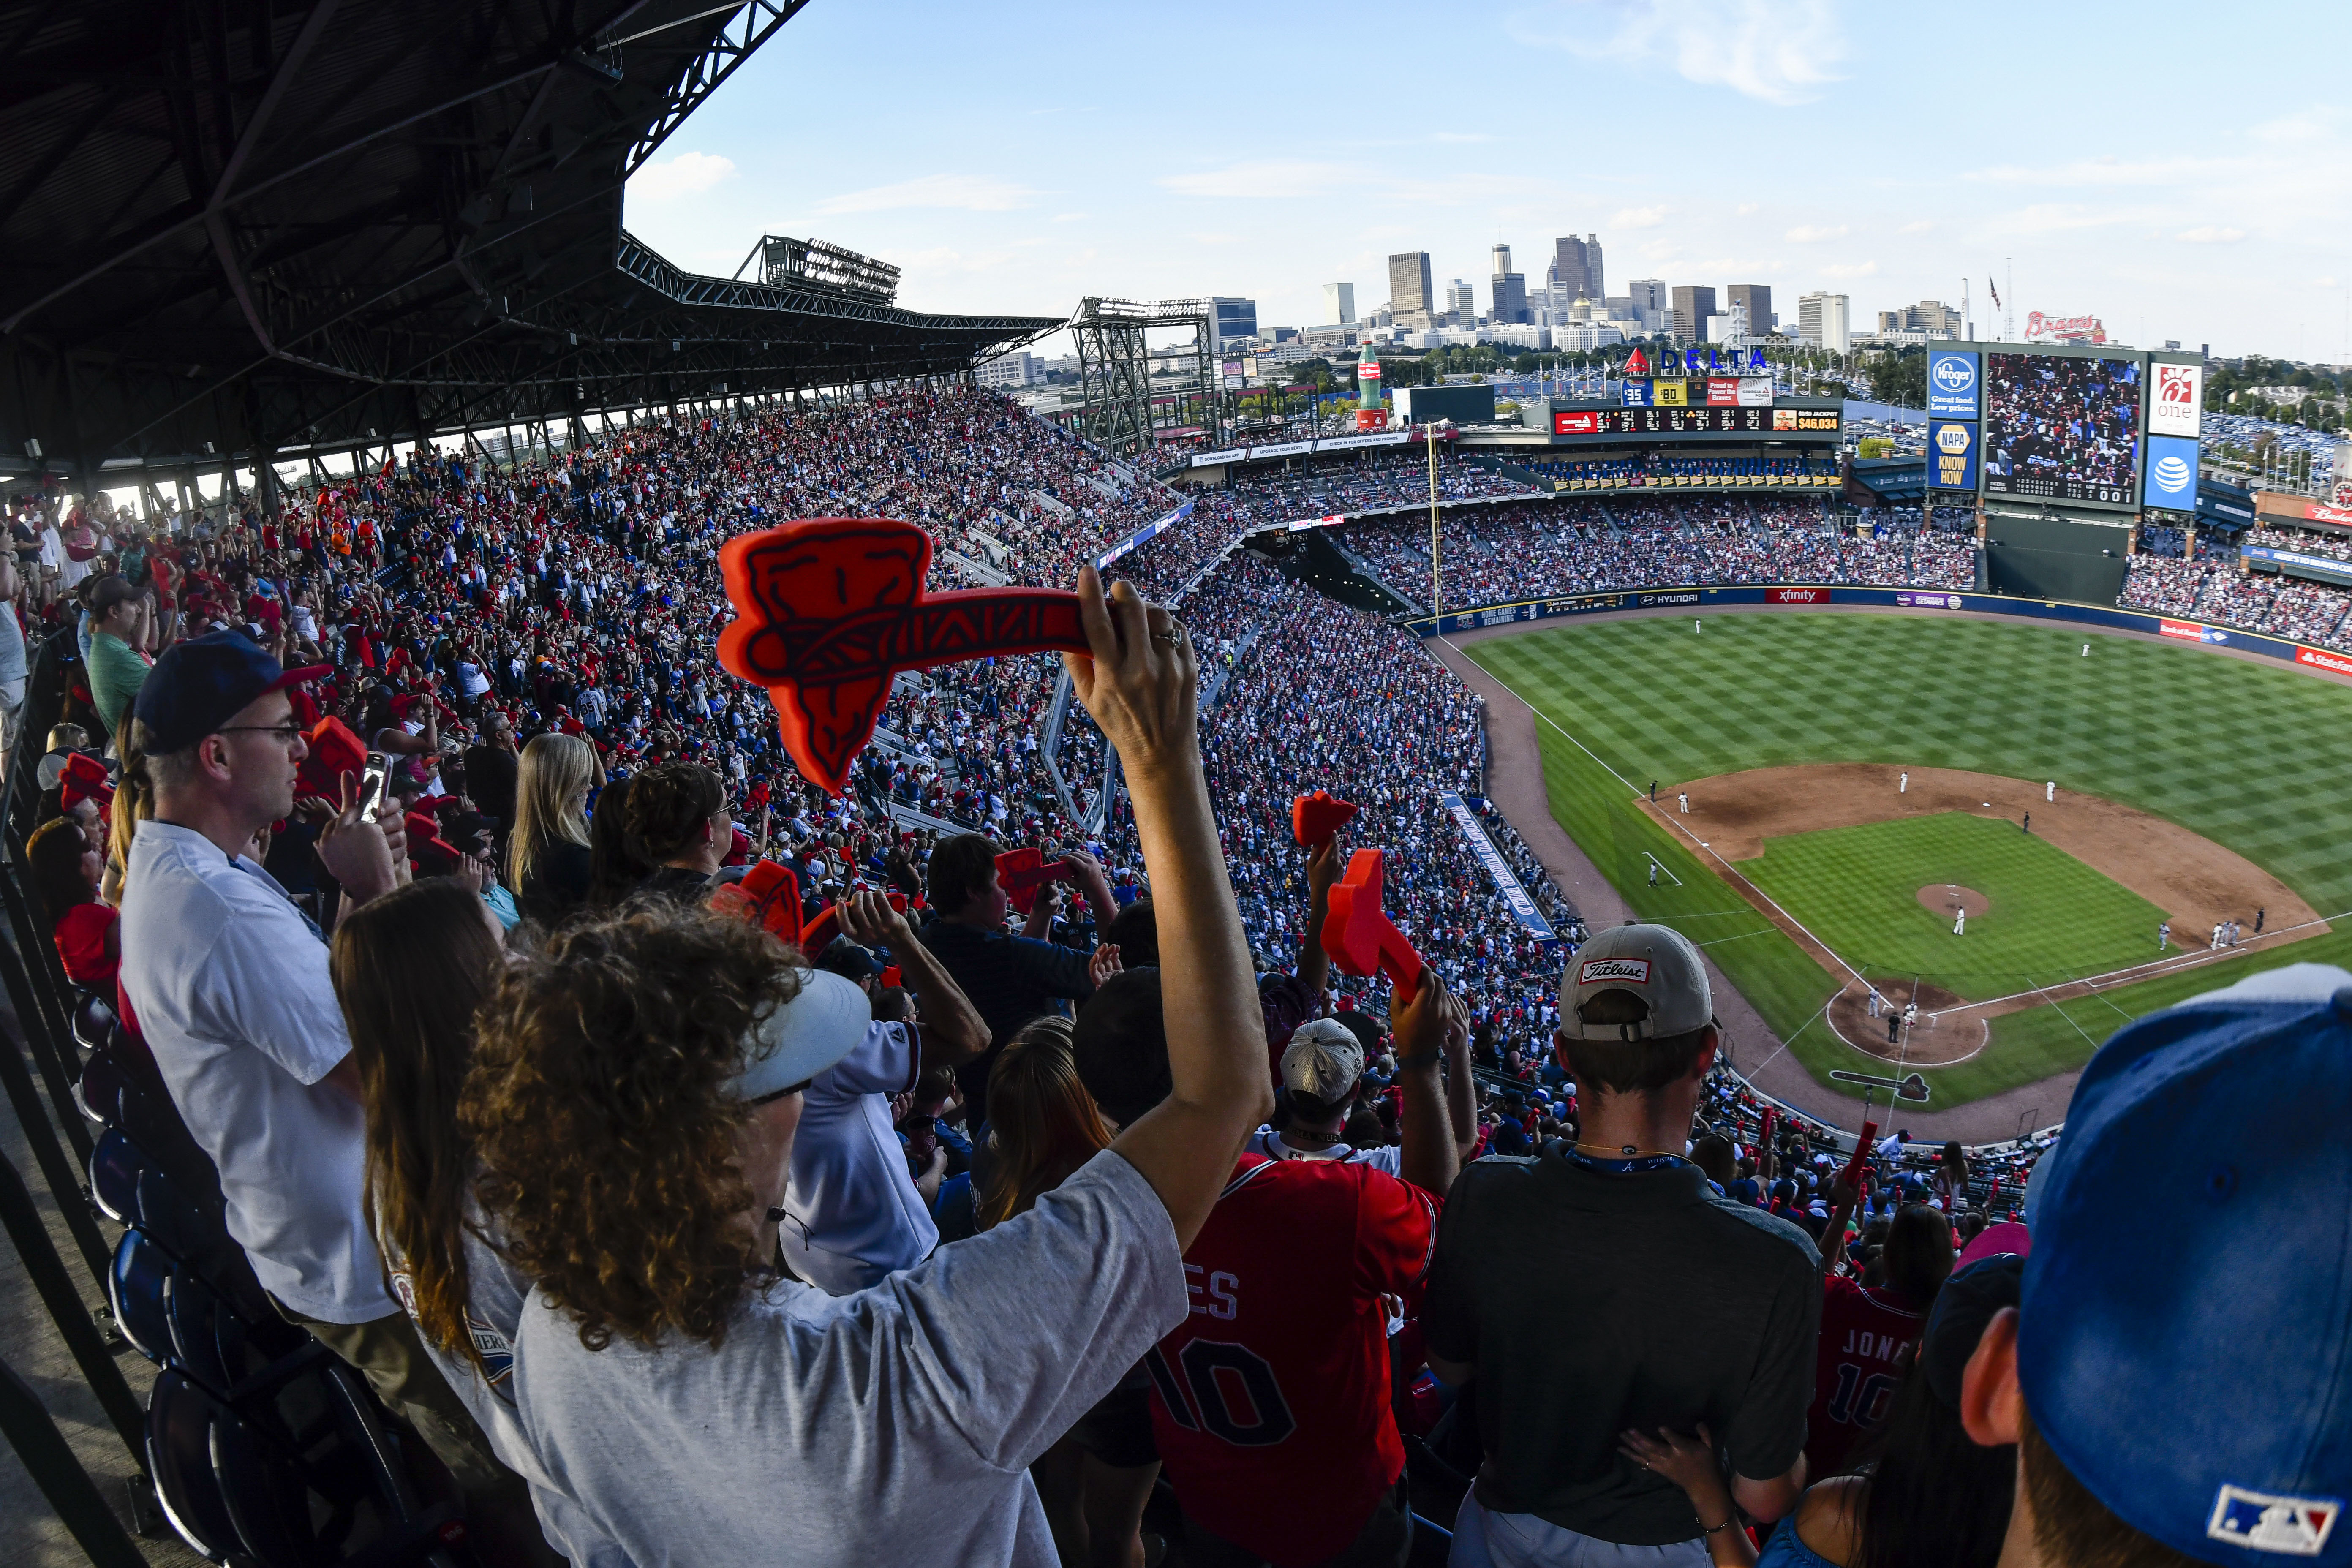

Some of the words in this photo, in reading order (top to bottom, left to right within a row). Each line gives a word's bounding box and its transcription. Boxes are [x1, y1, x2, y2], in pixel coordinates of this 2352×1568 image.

[2025, 311, 2093, 339] Braves
[1661, 349, 1767, 369] DELTA
[1938, 363, 1970, 387] Kroger
[1624, 389, 1642, 400] $35
[1660, 389, 1676, 400] $80
[1948, 405, 1976, 413] prices.
[2159, 405, 2191, 418] one
[1798, 418, 1838, 430] $46,034
[1941, 433, 1965, 447] NAPA
[1938, 455, 1967, 471] KNOW
[1941, 470, 1963, 485] HOW
[2099, 490, 2108, 501] 0
[2112, 492, 2121, 502] 0
[2126, 493, 2130, 503] 1
[2273, 553, 2299, 563] HERE'S
[2299, 556, 2310, 564] TO
[2310, 558, 2339, 569] BRAVES
[1658, 594, 1698, 604] HYUNDAI
[1779, 589, 1816, 602] xfinity
[1481, 610, 1497, 619] HOME
[1497, 606, 1516, 616] GAMES
[1484, 614, 1514, 626] REMAINING
[2160, 624, 2177, 633] Bank
[581, 701, 595, 715] 35
[1450, 804, 1486, 846] WELCOME
[1474, 843, 1493, 854] TO
[1481, 852, 1516, 889] TURNER
[1503, 886, 1535, 915] FIELD
[1583, 960, 1646, 980] Titleist
[1143, 1337, 1297, 1447] 10
